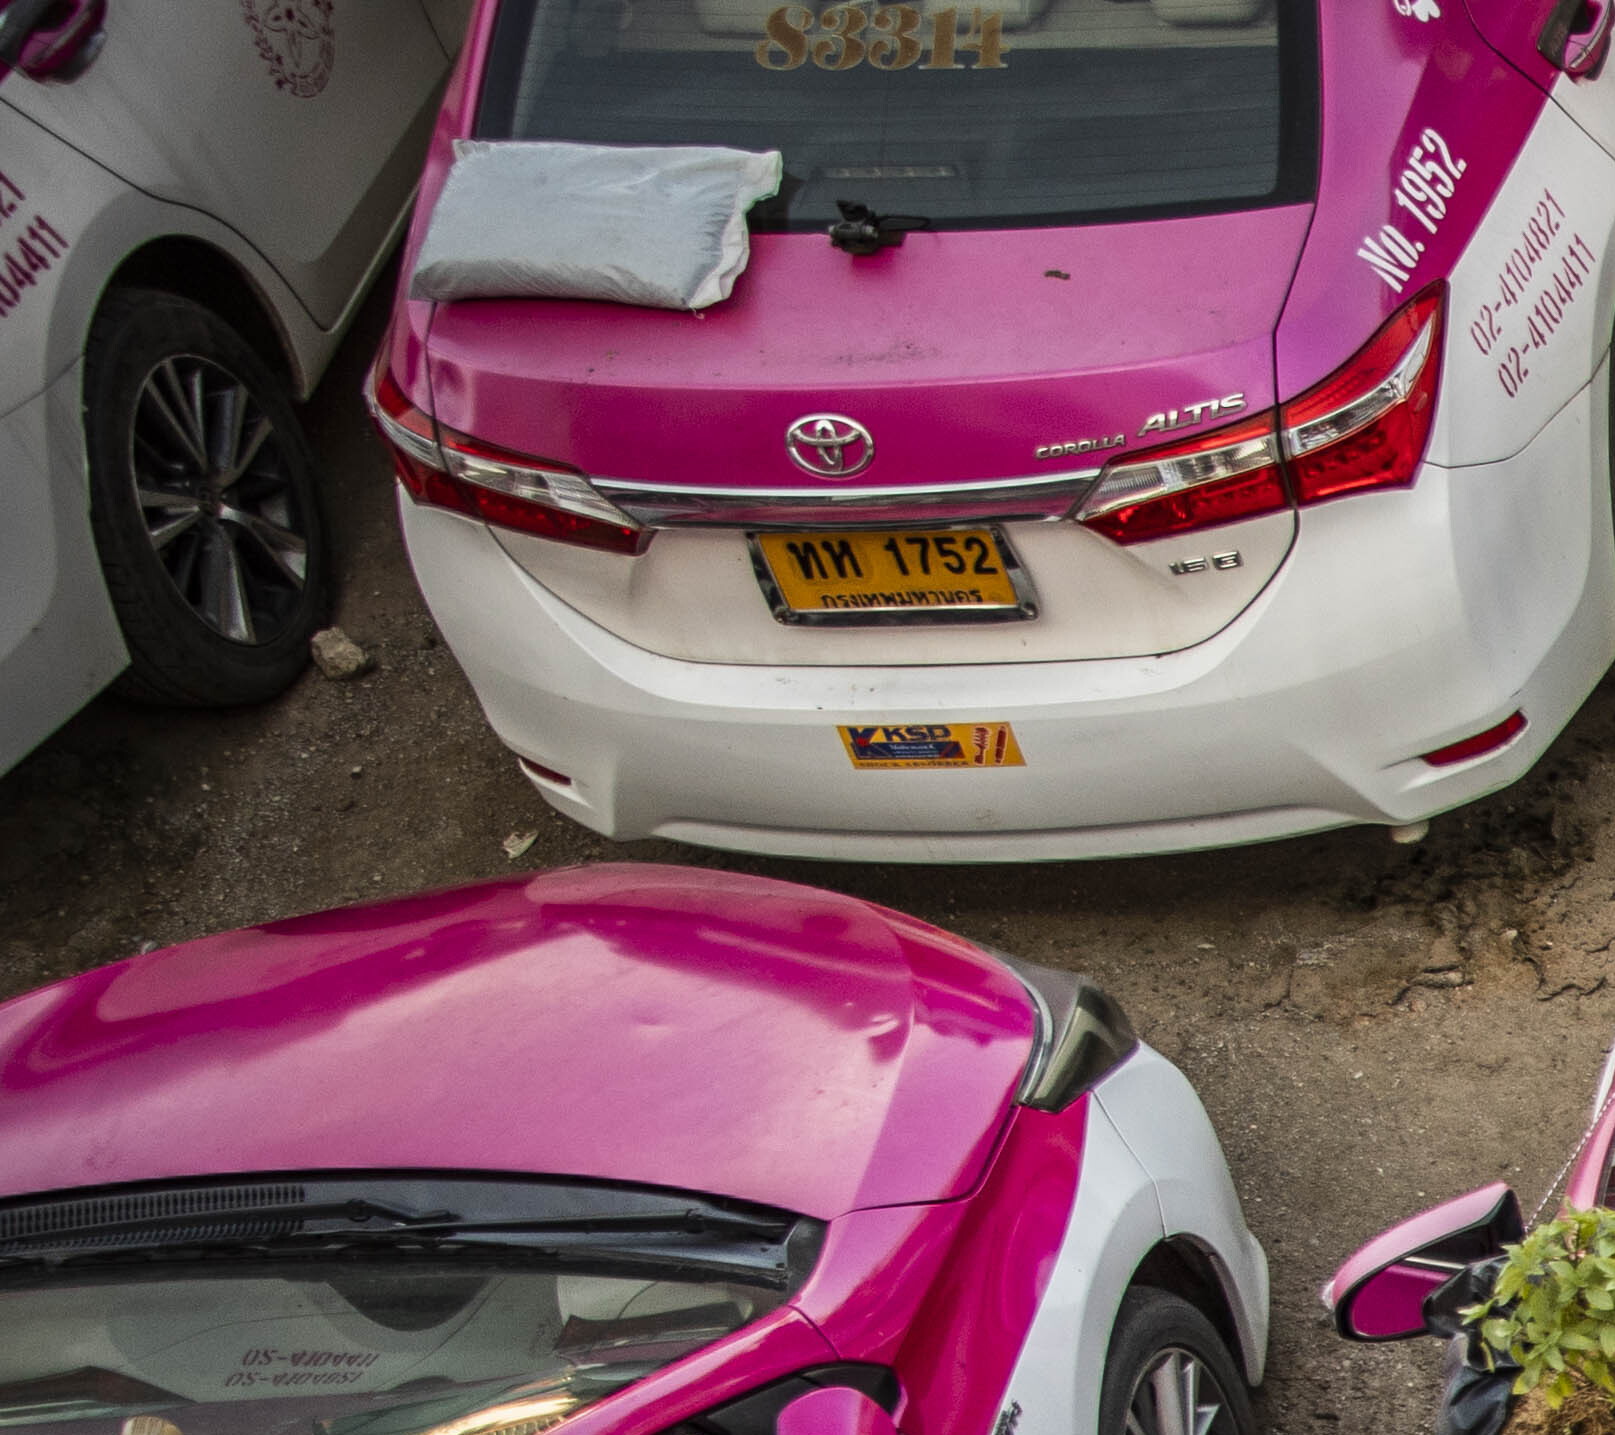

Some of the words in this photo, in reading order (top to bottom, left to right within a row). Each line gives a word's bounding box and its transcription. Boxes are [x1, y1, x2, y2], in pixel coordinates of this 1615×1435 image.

[754, 5, 1012, 71] 83314
[1357, 224, 1426, 294] No.
[1394, 128, 1467, 235] 1952
[1468, 187, 1566, 356] 02-4104821
[1496, 233, 1598, 398] 02-4104411
[1035, 434, 1126, 459] COROLLA
[1138, 393, 1248, 437] ALTIS
[884, 537, 998, 576] 1752
